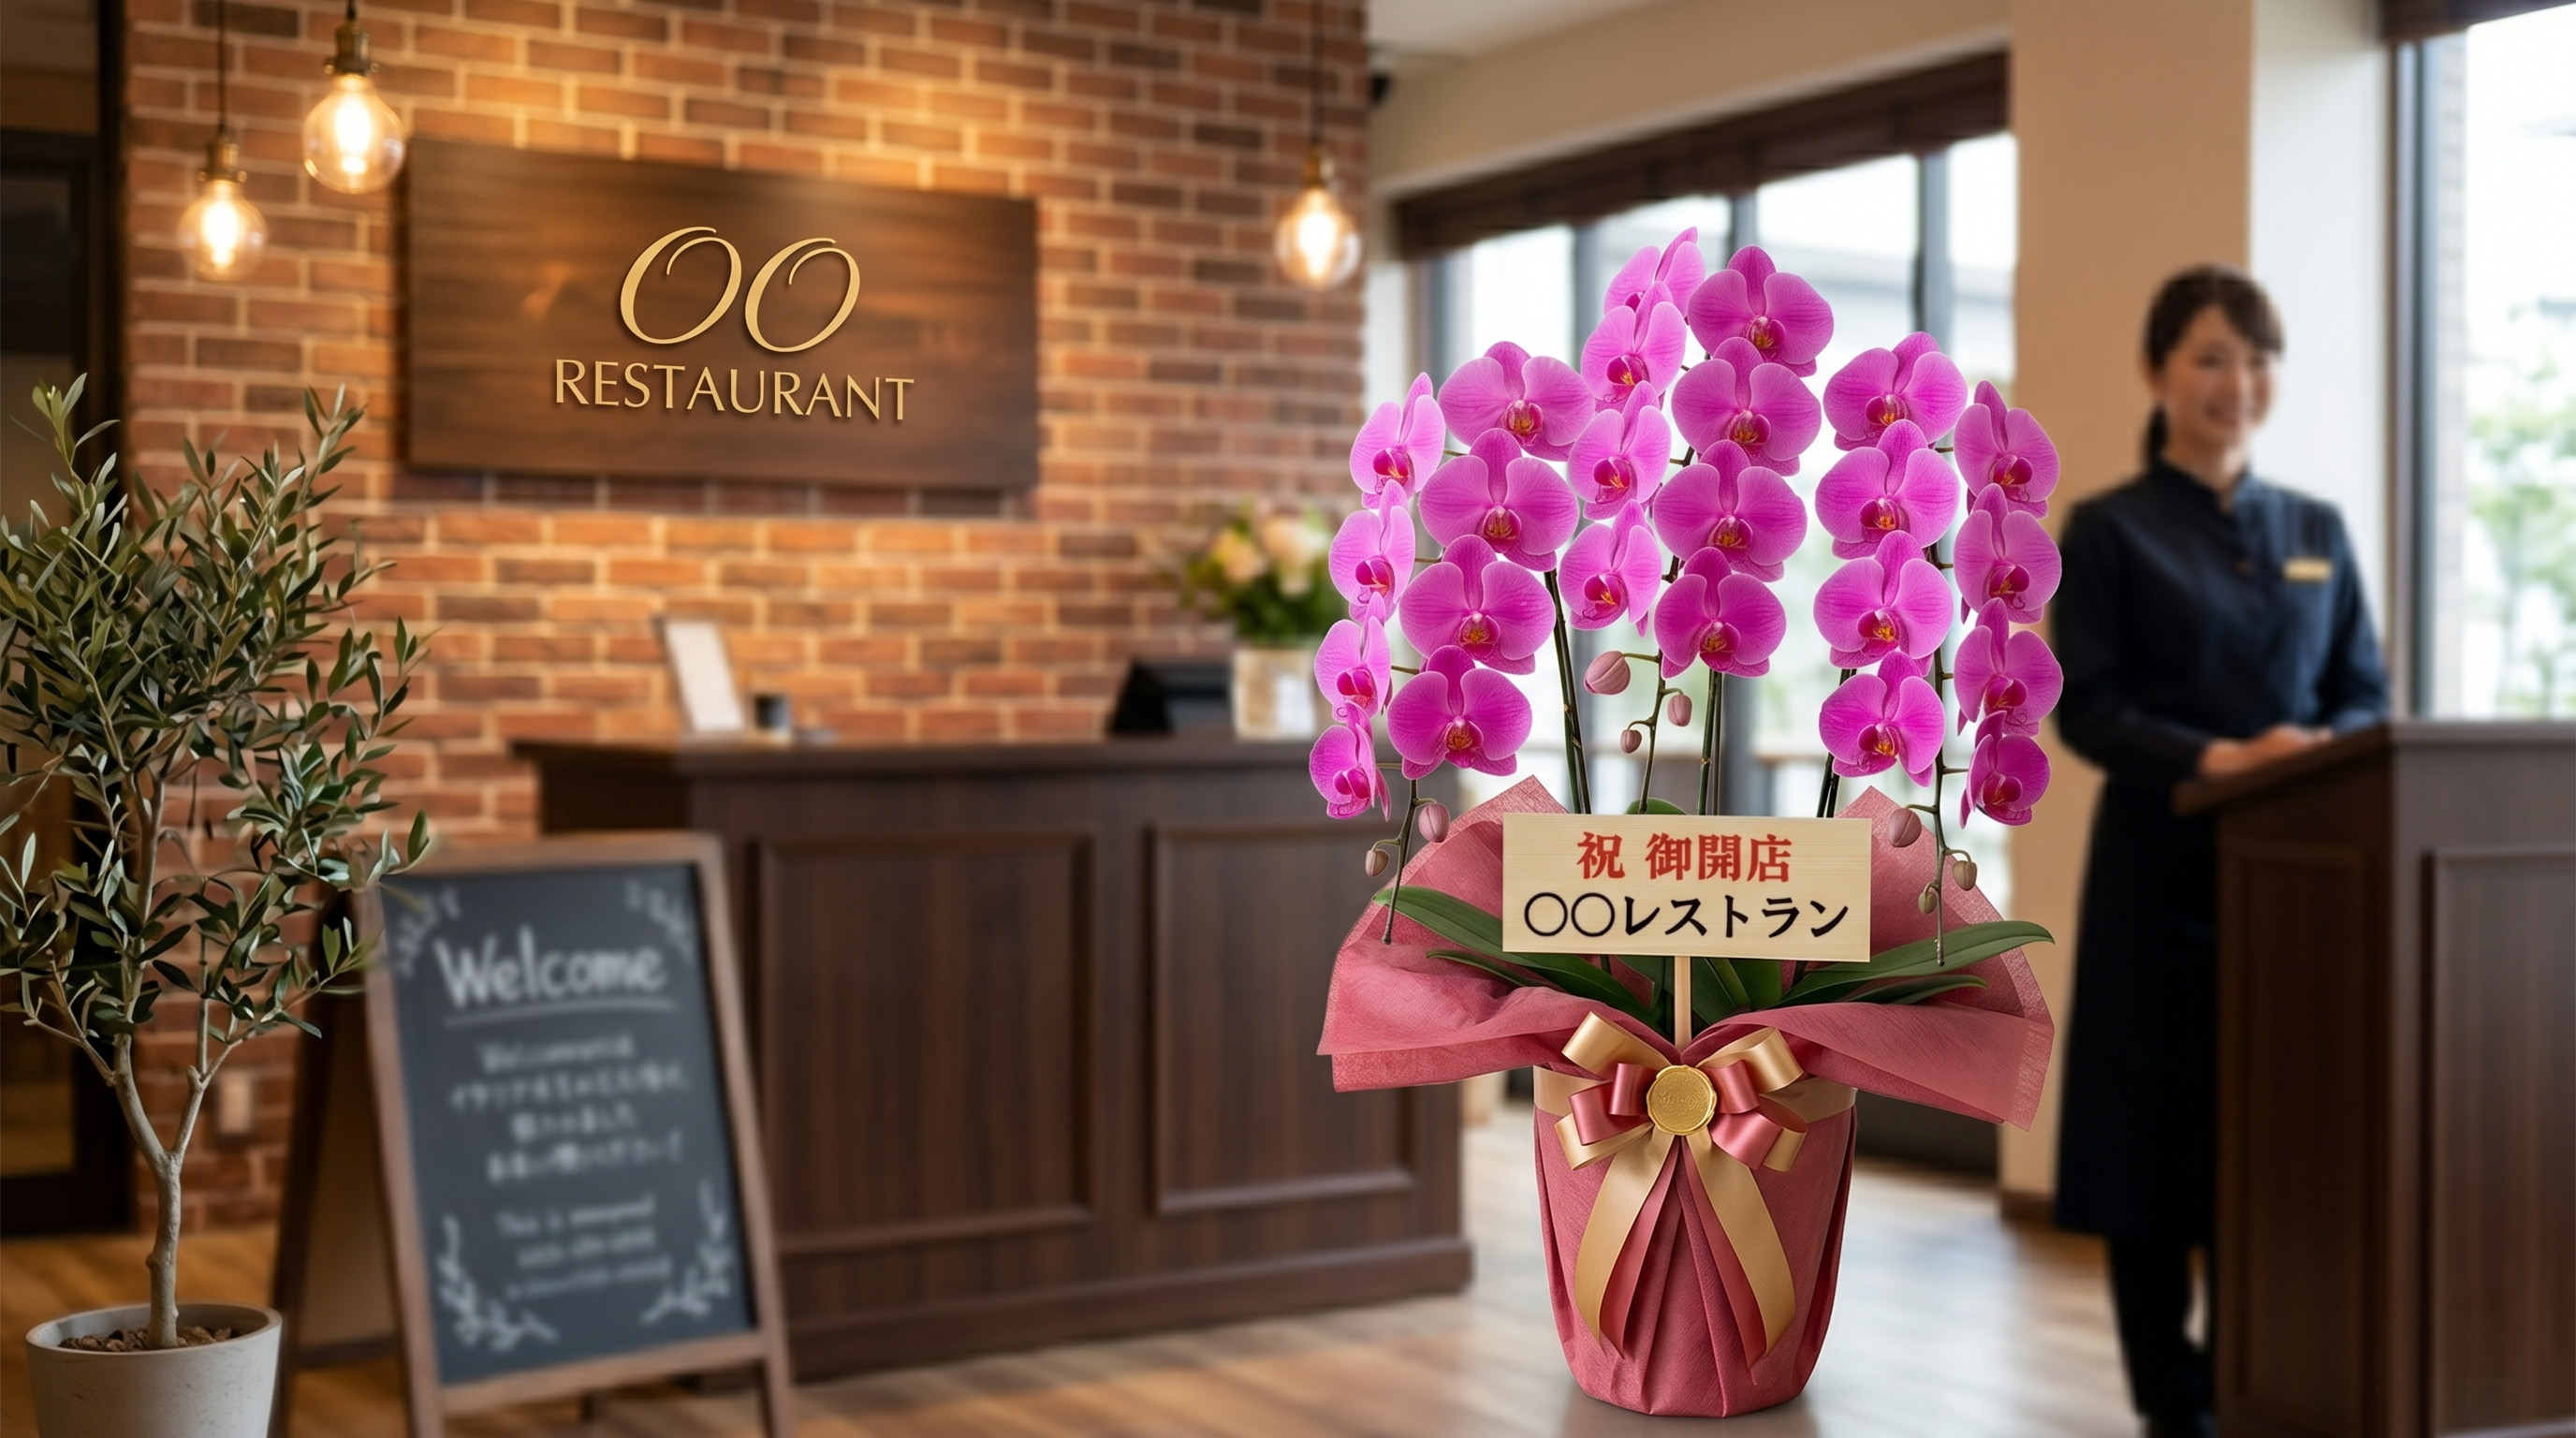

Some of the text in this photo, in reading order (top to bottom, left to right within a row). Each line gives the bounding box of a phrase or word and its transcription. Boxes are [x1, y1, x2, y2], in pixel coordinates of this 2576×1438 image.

[556, 360, 914, 420] RESTAURANT
[1577, 831, 1792, 883] 祝 御開店
[436, 924, 668, 1009] Welcome
